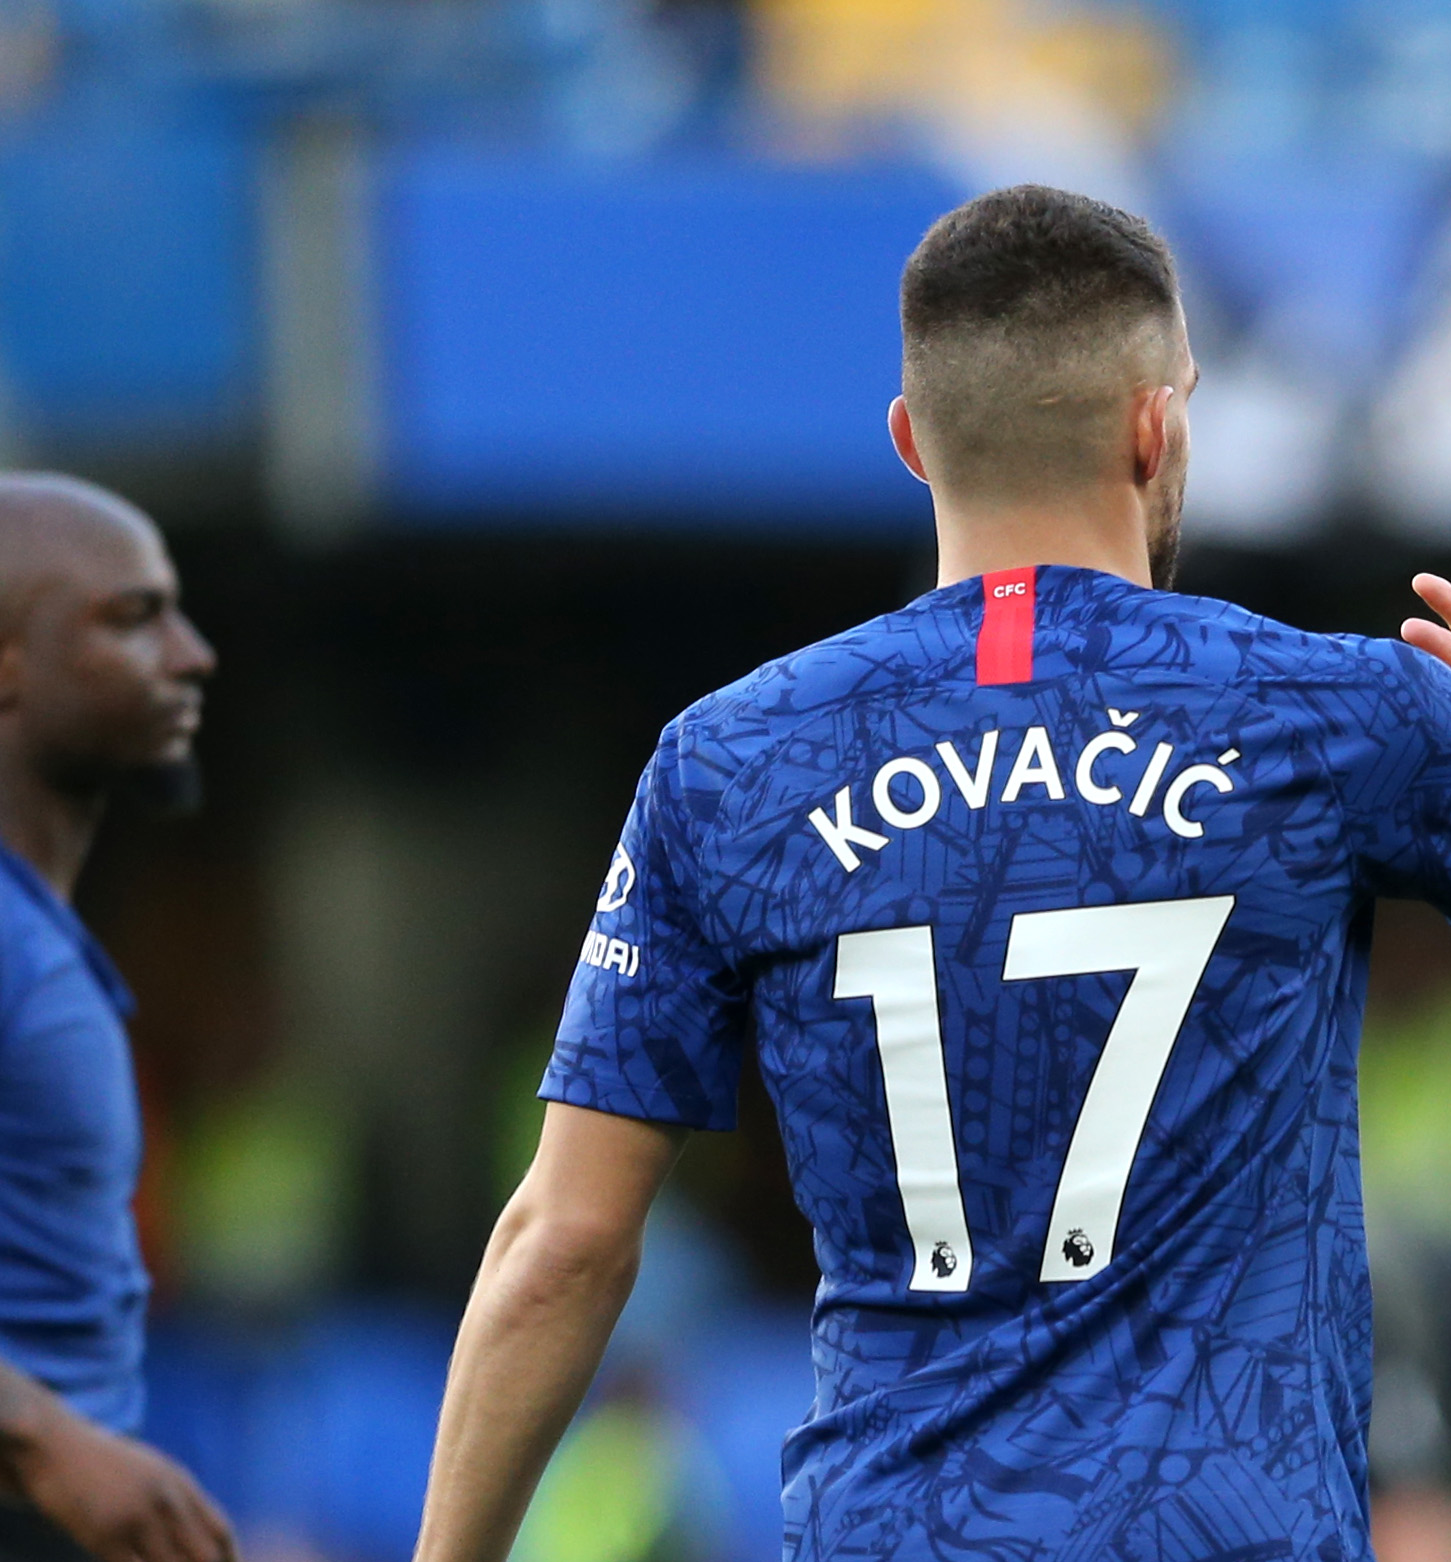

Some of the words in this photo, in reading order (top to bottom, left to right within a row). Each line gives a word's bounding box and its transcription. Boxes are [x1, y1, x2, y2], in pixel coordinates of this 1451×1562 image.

[993, 582, 1026, 599] CFC
[808, 707, 1241, 873] KOVAČIĆ
[832, 895, 1236, 1293] 17
